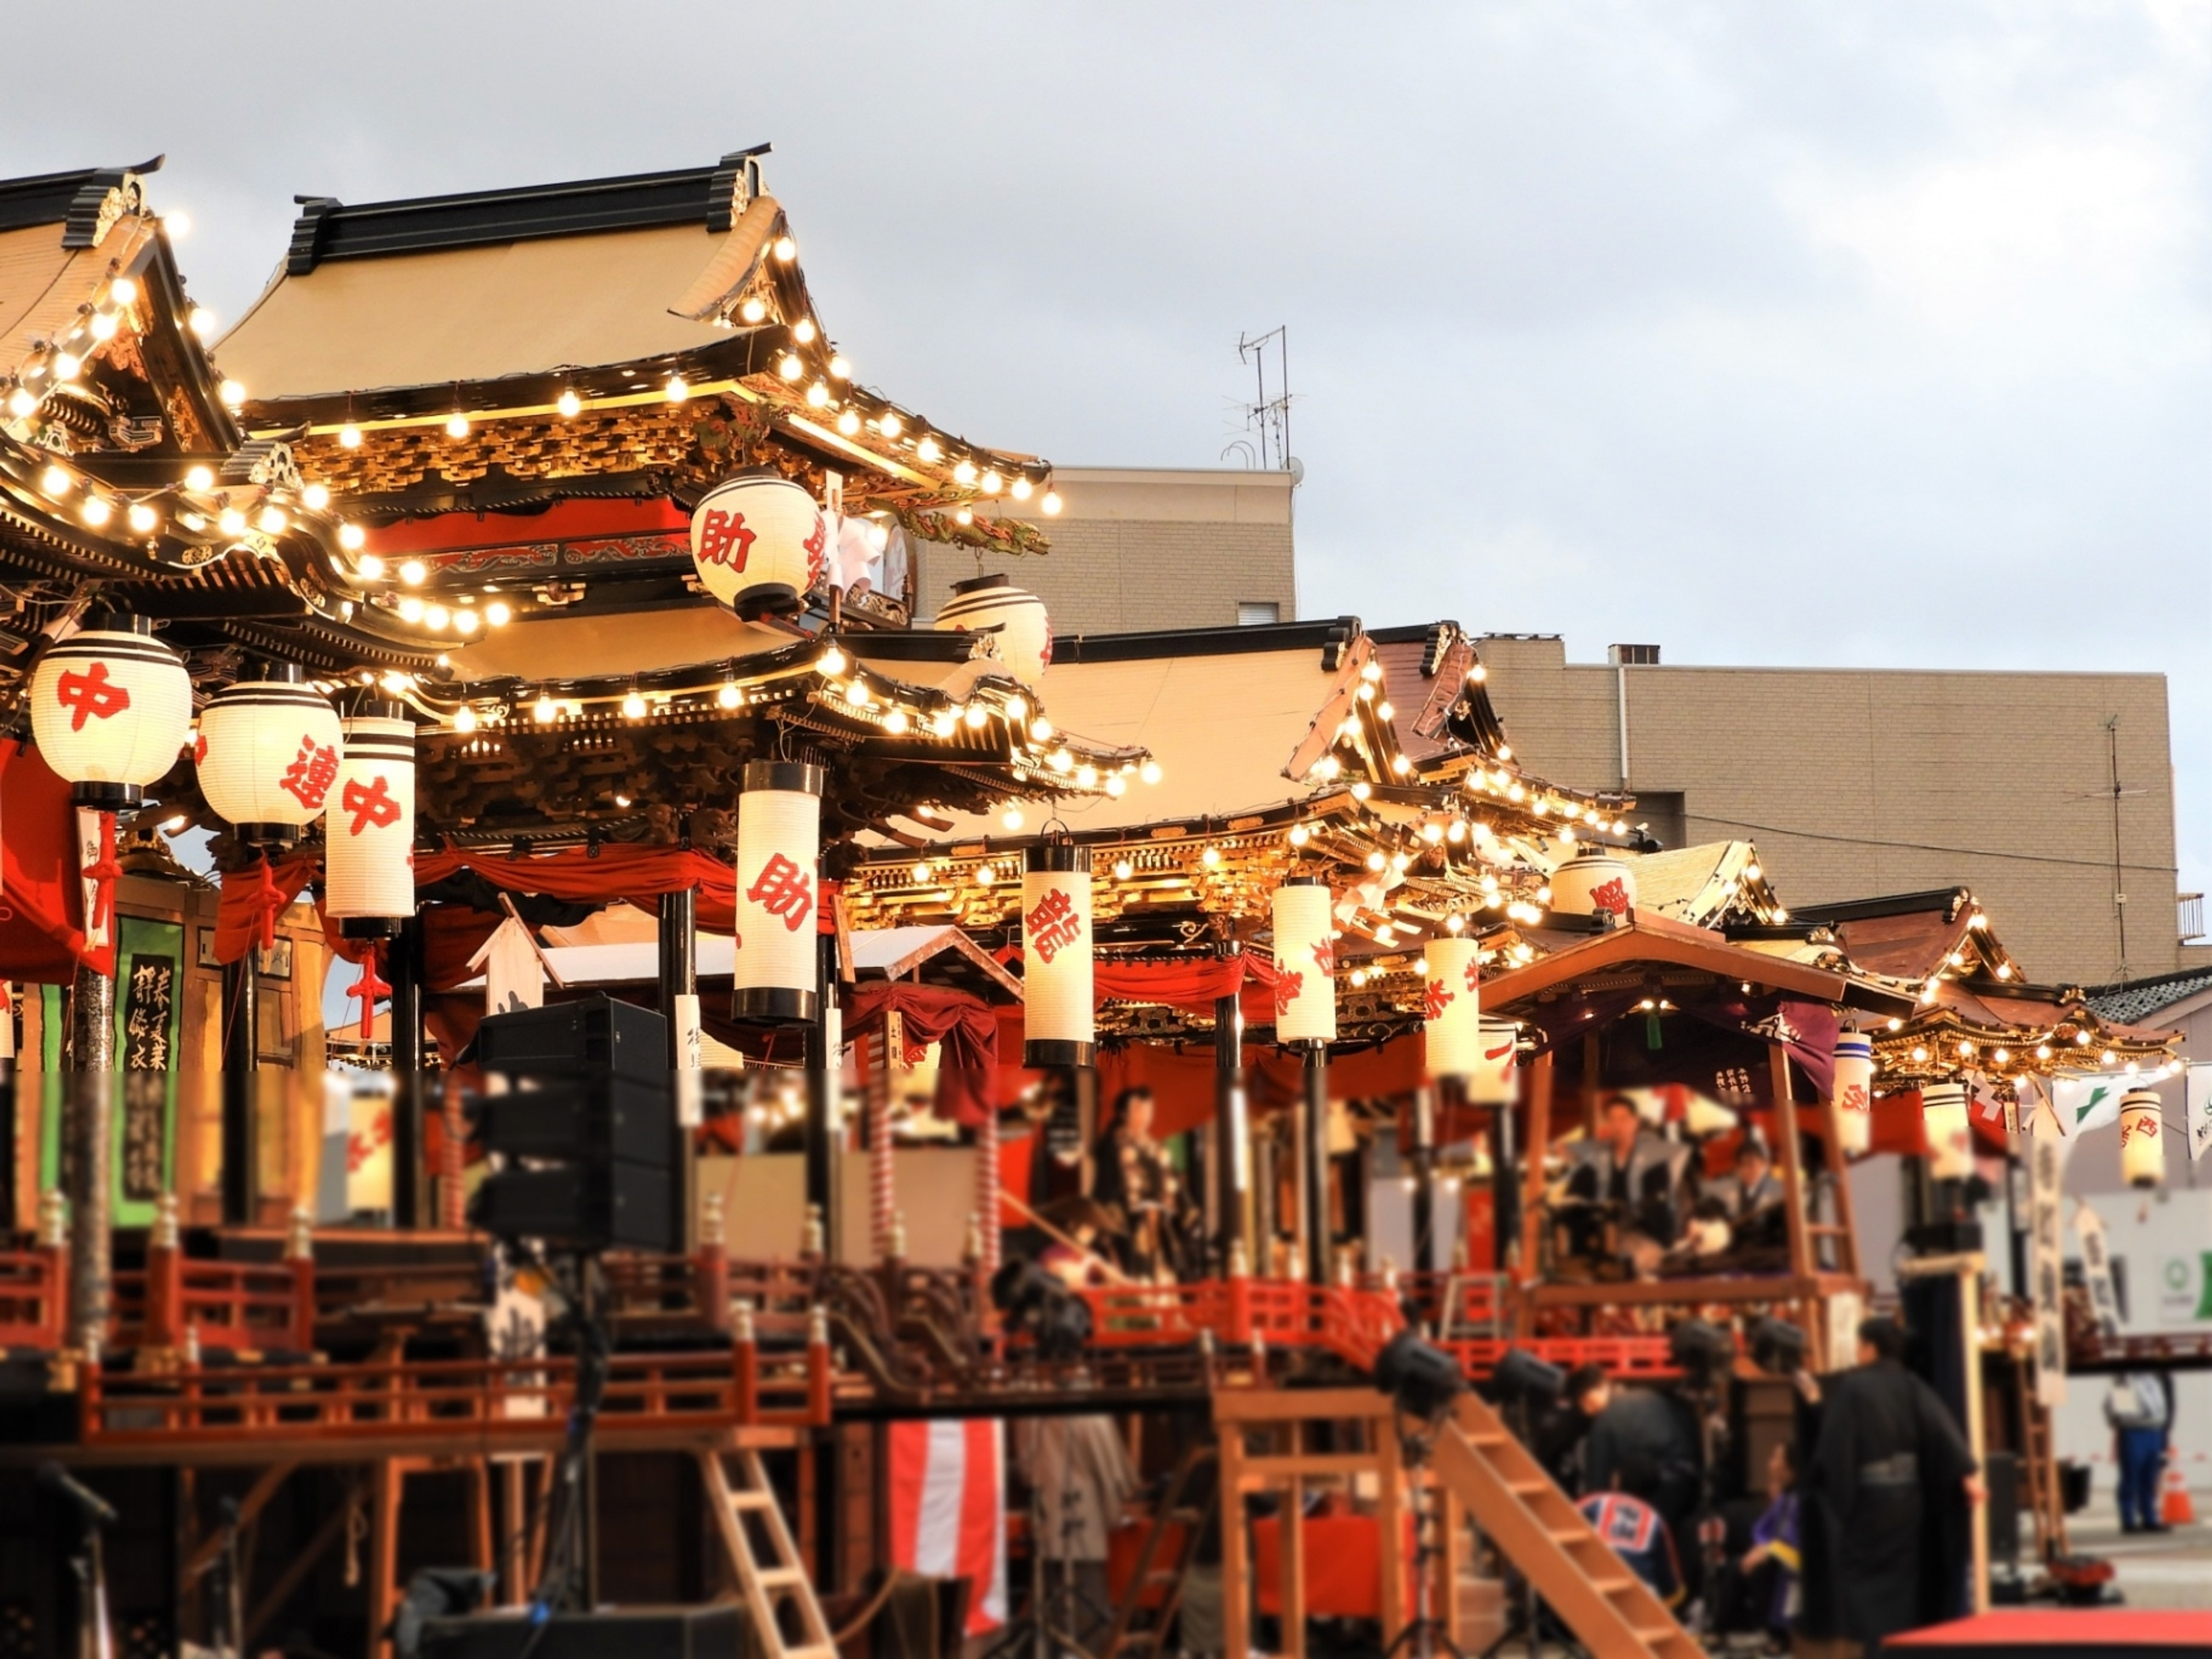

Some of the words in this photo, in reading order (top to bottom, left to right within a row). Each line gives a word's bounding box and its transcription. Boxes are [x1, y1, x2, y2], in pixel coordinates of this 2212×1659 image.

[698, 509, 756, 573] 助
[58, 661, 130, 732] 中
[279, 734, 339, 809] 連
[342, 775, 402, 836] 中
[746, 853, 813, 932] 助
[1025, 888, 1081, 964] 龍
